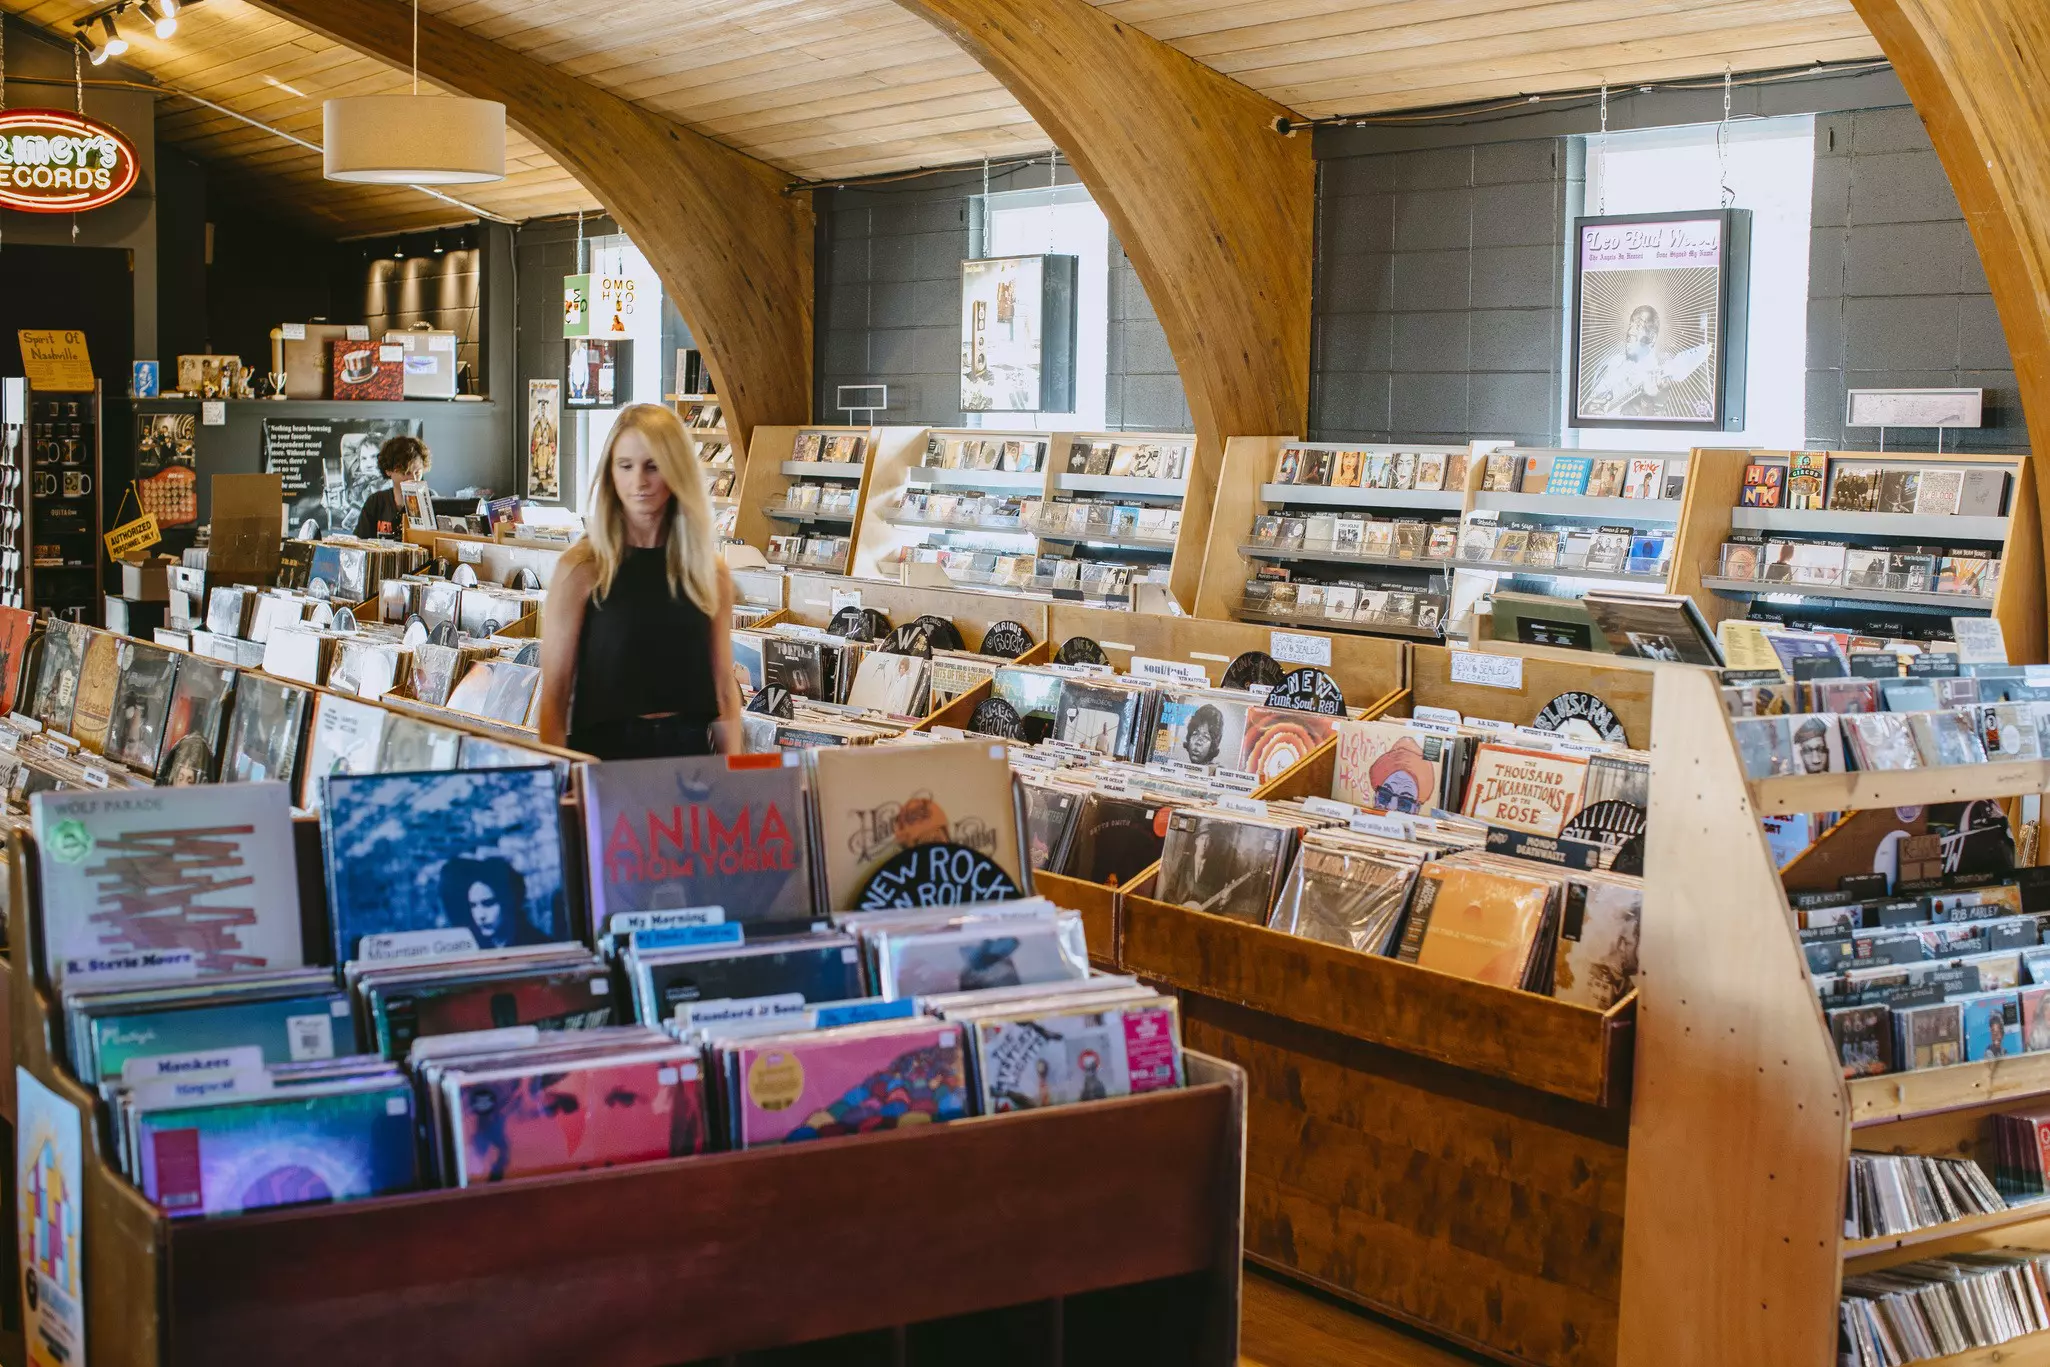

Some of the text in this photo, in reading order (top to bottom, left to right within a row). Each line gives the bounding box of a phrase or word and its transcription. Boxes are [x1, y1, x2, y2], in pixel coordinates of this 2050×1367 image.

[1586, 231, 1621, 251] Leo
[1626, 229, 1662, 250] Bud
[23, 332, 54, 348] Spirit
[30, 347, 78, 360] Nashville
[291, 432, 312, 440] favorite
[292, 424, 306, 432] beats
[307, 424, 332, 434] browsing
[305, 441, 322, 449] record
[1792, 468, 1819, 478] CIRCUS
[110, 521, 152, 546] AUTHORIZED
[113, 531, 154, 556] PERSONNEL ONLY
[994, 621, 1022, 636] VARIOUS
[1273, 642, 1287, 651] NEW
[1295, 644, 1319, 655] SEALED
[947, 669, 955, 680] OF
[955, 670, 967, 681] THE
[1480, 665, 1508, 676] SEALED
[1287, 670, 1333, 698] NEW
[979, 716, 1020, 740] BROWN
[1495, 764, 1563, 785] THOUSAND
[1482, 778, 1566, 813] INCARNATIONS
[54, 798, 164, 816] WOLF PARADE
[1496, 803, 1541, 825] ROSE
[604, 799, 796, 864] ANIMA
[608, 847, 797, 885] THOM YORKE
[860, 846, 1014, 912] NEW ROCK
[628, 912, 707, 929] My Morning
[1951, 906, 1998, 922] BOB MARLEY
[89, 956, 140, 972] Stevie
[142, 952, 192, 968] Moore
[158, 1058, 231, 1073] Monkees
